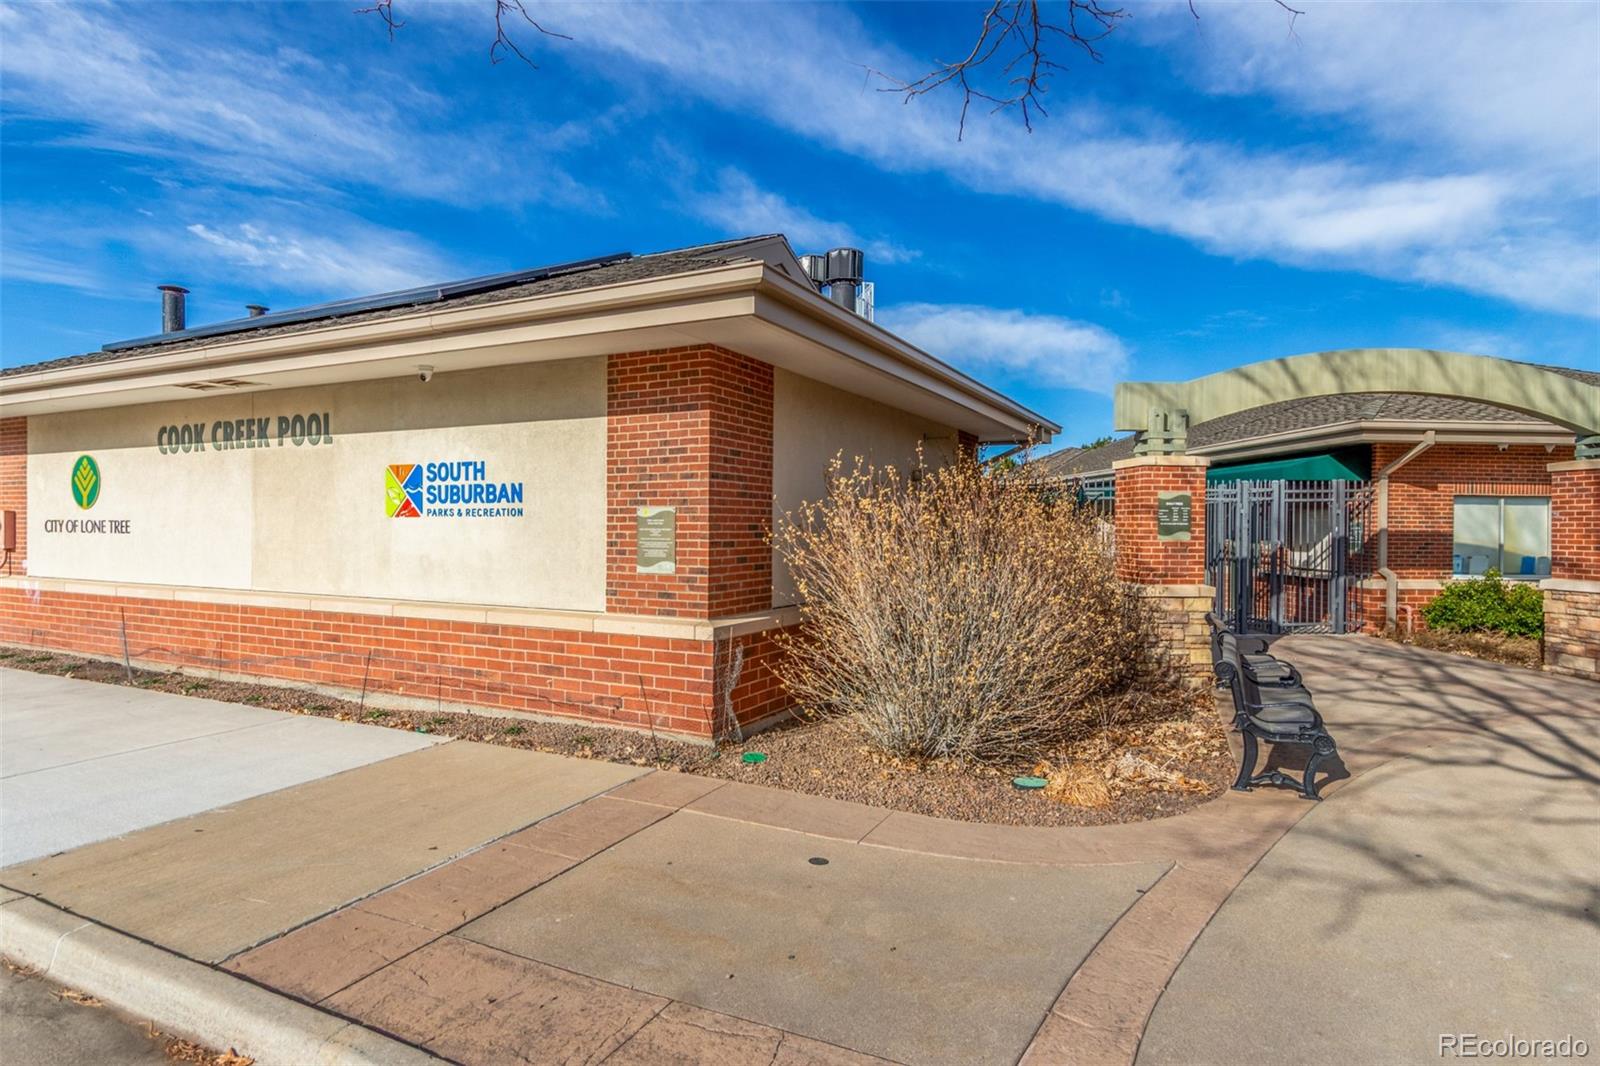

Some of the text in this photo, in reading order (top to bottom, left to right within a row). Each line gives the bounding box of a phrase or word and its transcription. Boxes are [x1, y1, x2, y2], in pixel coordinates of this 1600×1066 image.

[157, 412, 333, 455] COOK CREEK POOL
[426, 461, 485, 482] SOUTH
[426, 483, 523, 504] SUBURBAN
[427, 508, 523, 517] PARKS & RECREATION
[44, 519, 131, 534] CITY OF LONE TREE
